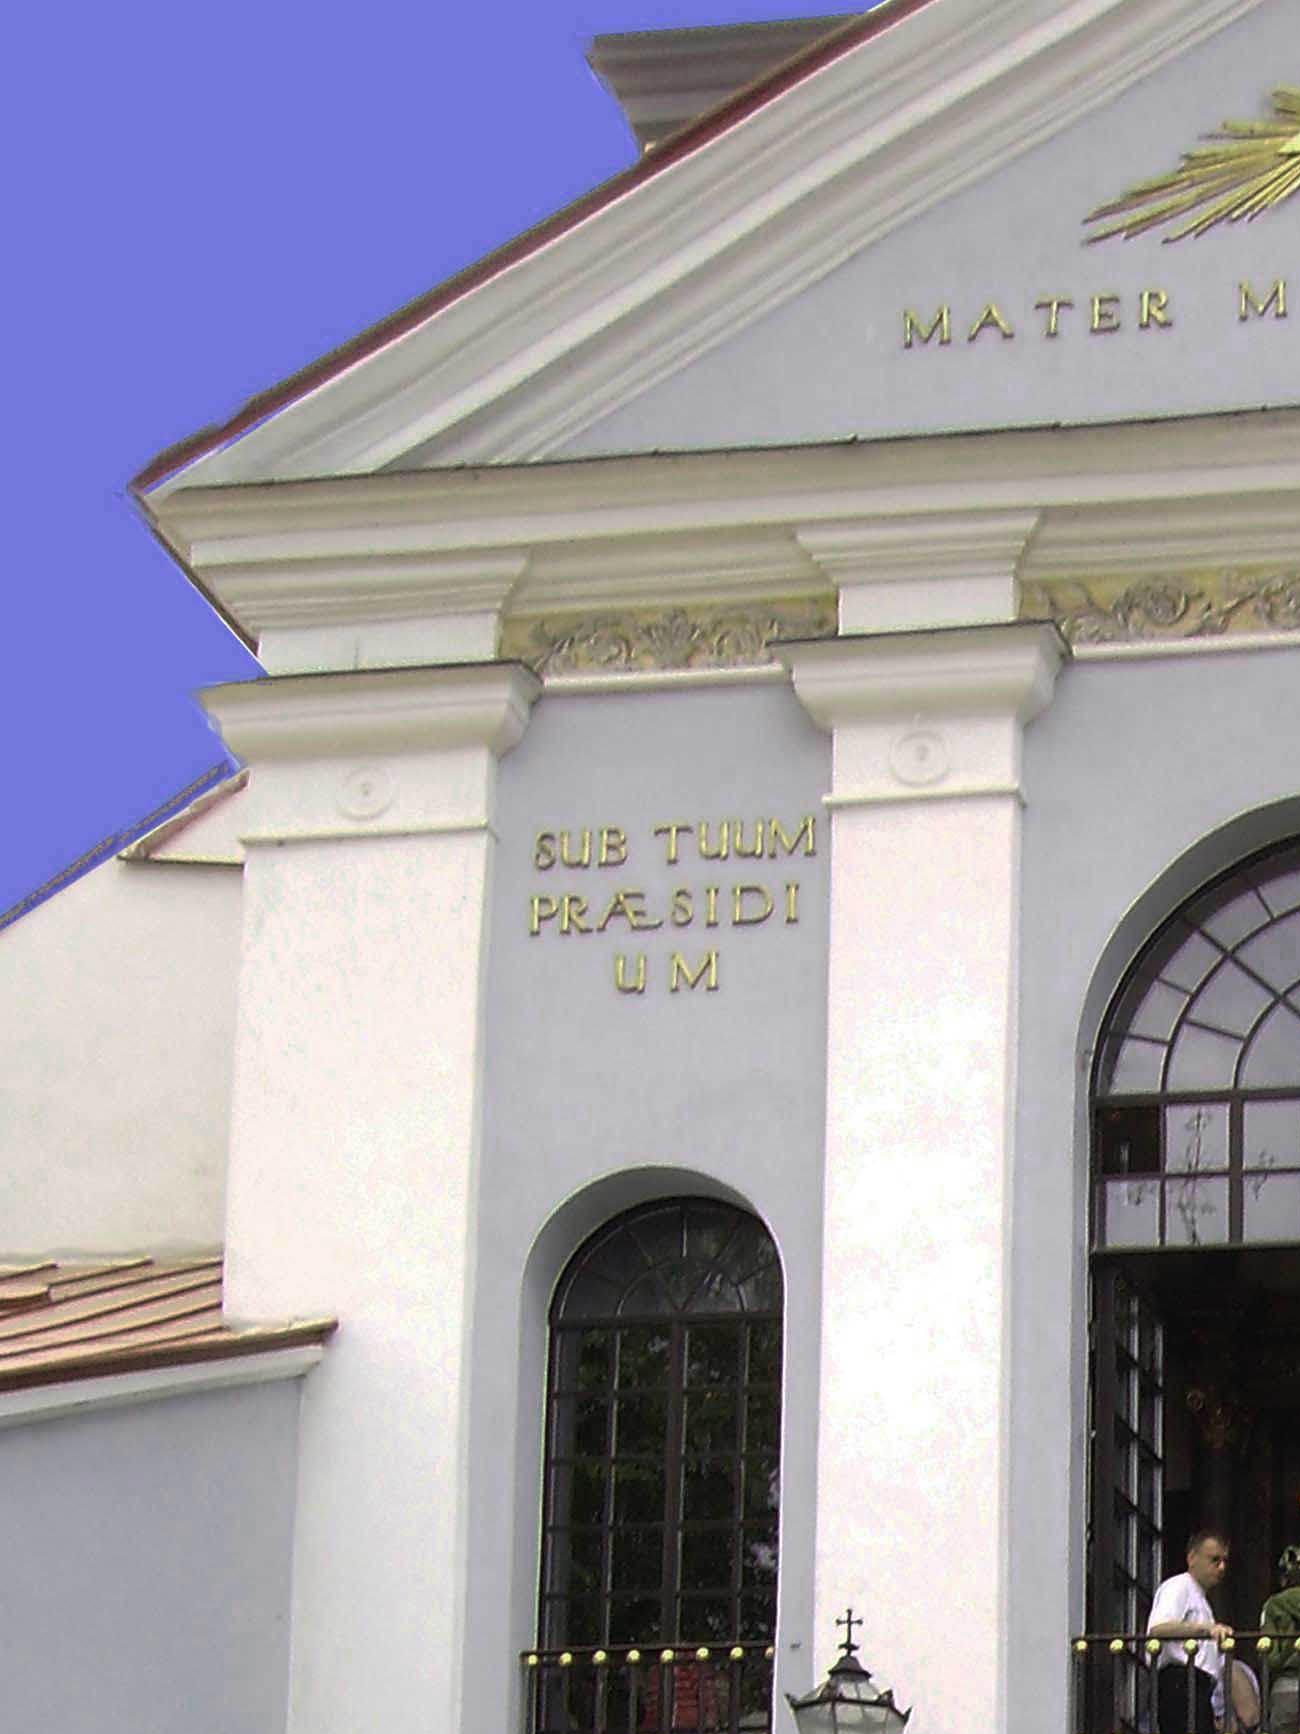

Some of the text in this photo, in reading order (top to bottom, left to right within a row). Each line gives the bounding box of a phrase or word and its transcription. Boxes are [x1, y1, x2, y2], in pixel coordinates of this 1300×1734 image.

[902, 288, 1175, 351] MATER
[532, 815, 819, 873] SUB TUUM
[528, 880, 801, 938] PRÆSIDI
[615, 949, 721, 996] UM
